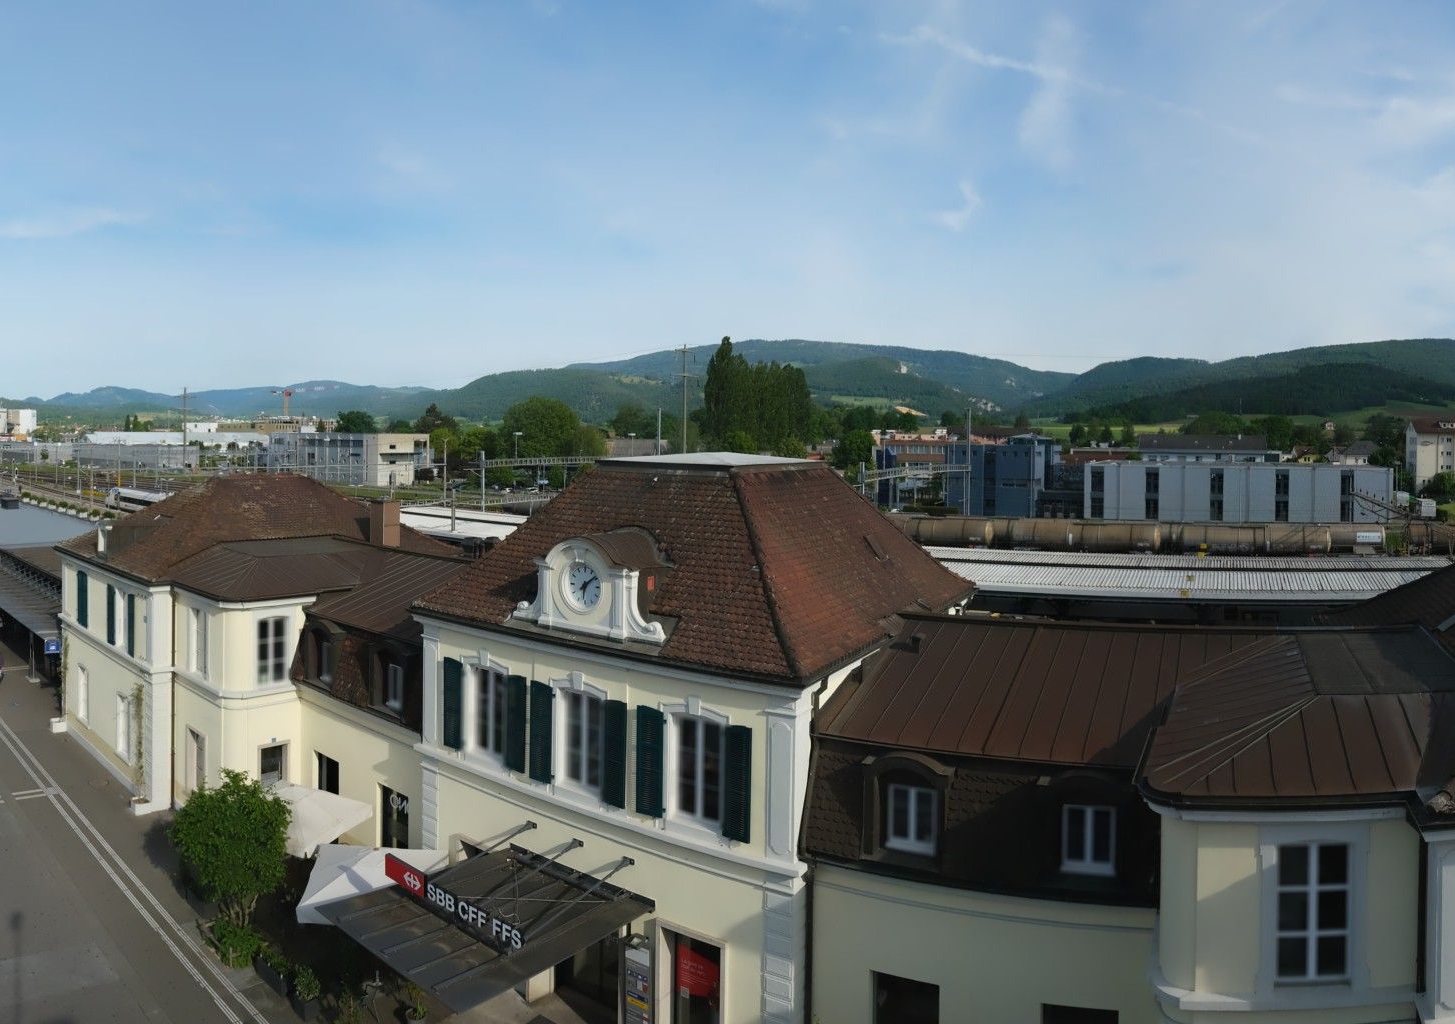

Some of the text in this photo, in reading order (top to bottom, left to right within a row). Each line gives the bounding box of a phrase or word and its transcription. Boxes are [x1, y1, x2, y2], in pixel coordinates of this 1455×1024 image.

[427, 884, 523, 950] SBB CFF FFS
